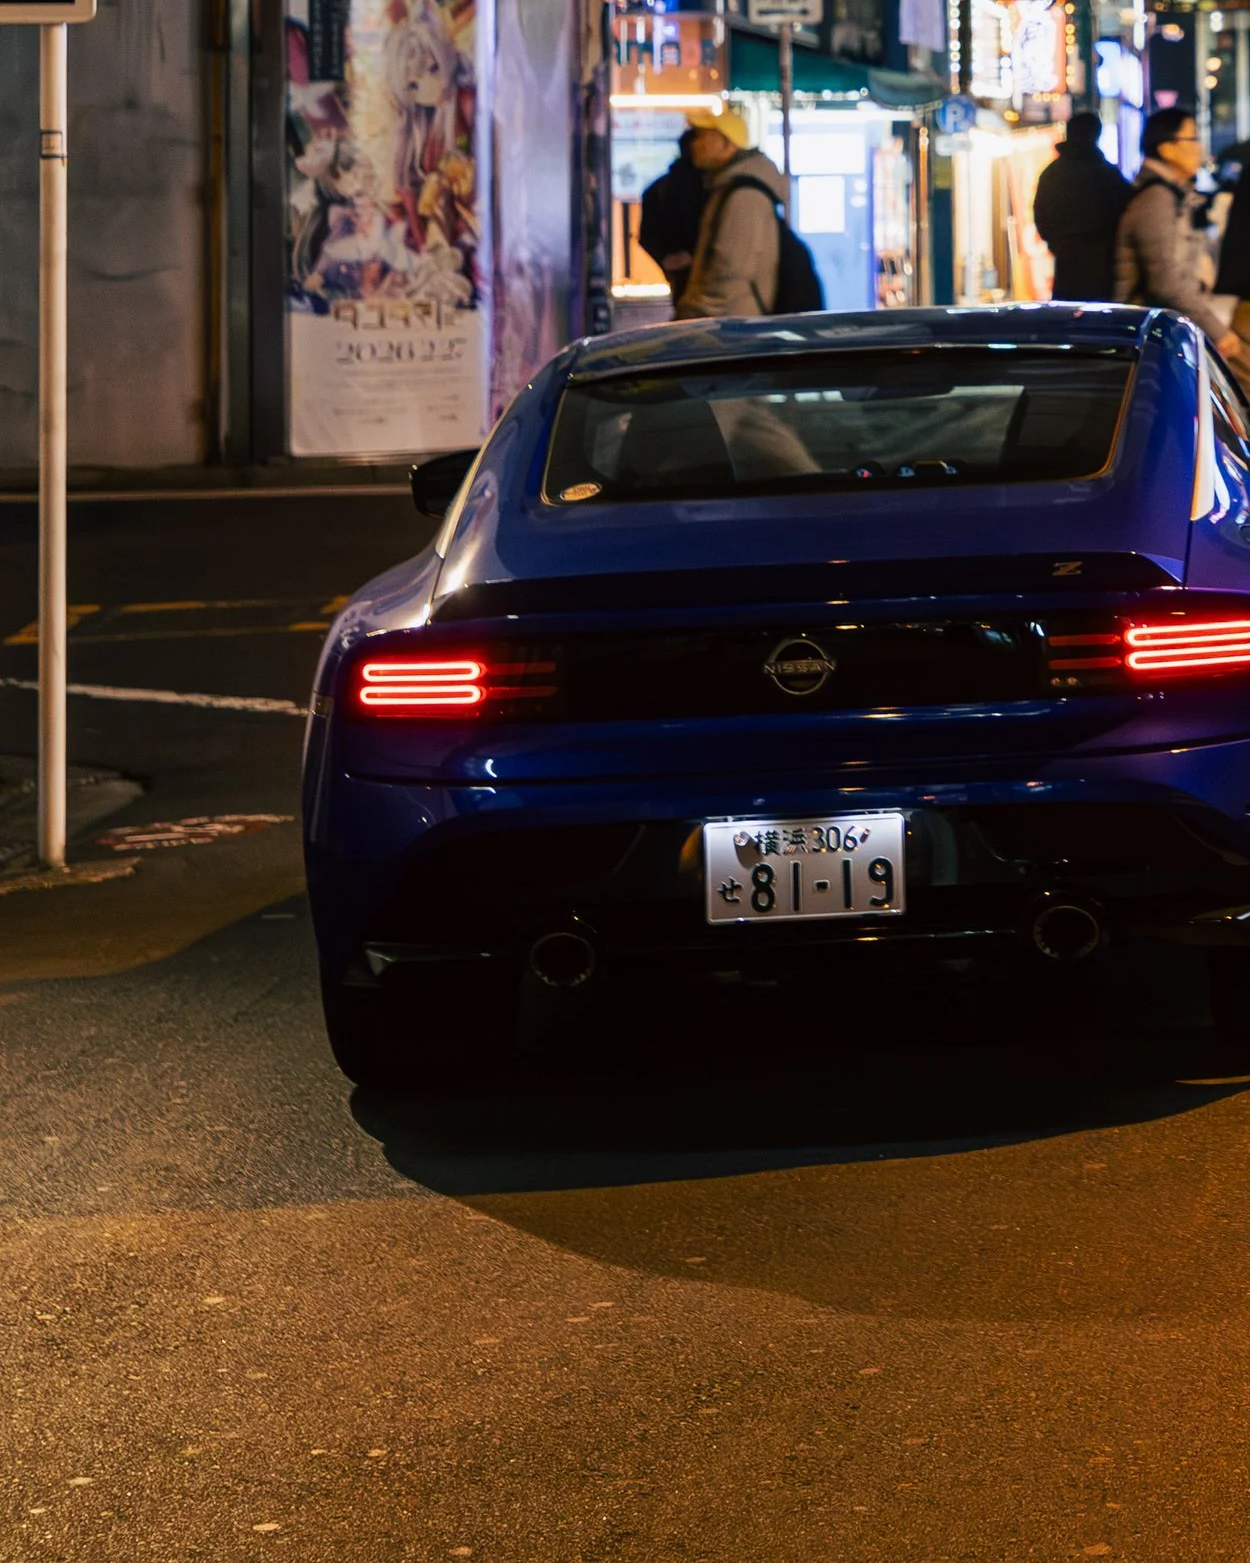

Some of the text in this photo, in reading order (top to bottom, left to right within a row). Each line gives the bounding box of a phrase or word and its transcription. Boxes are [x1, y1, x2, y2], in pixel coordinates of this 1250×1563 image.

[755, 825, 861, 856] 横浜 306
[717, 856, 893, 913] せ 81-19
